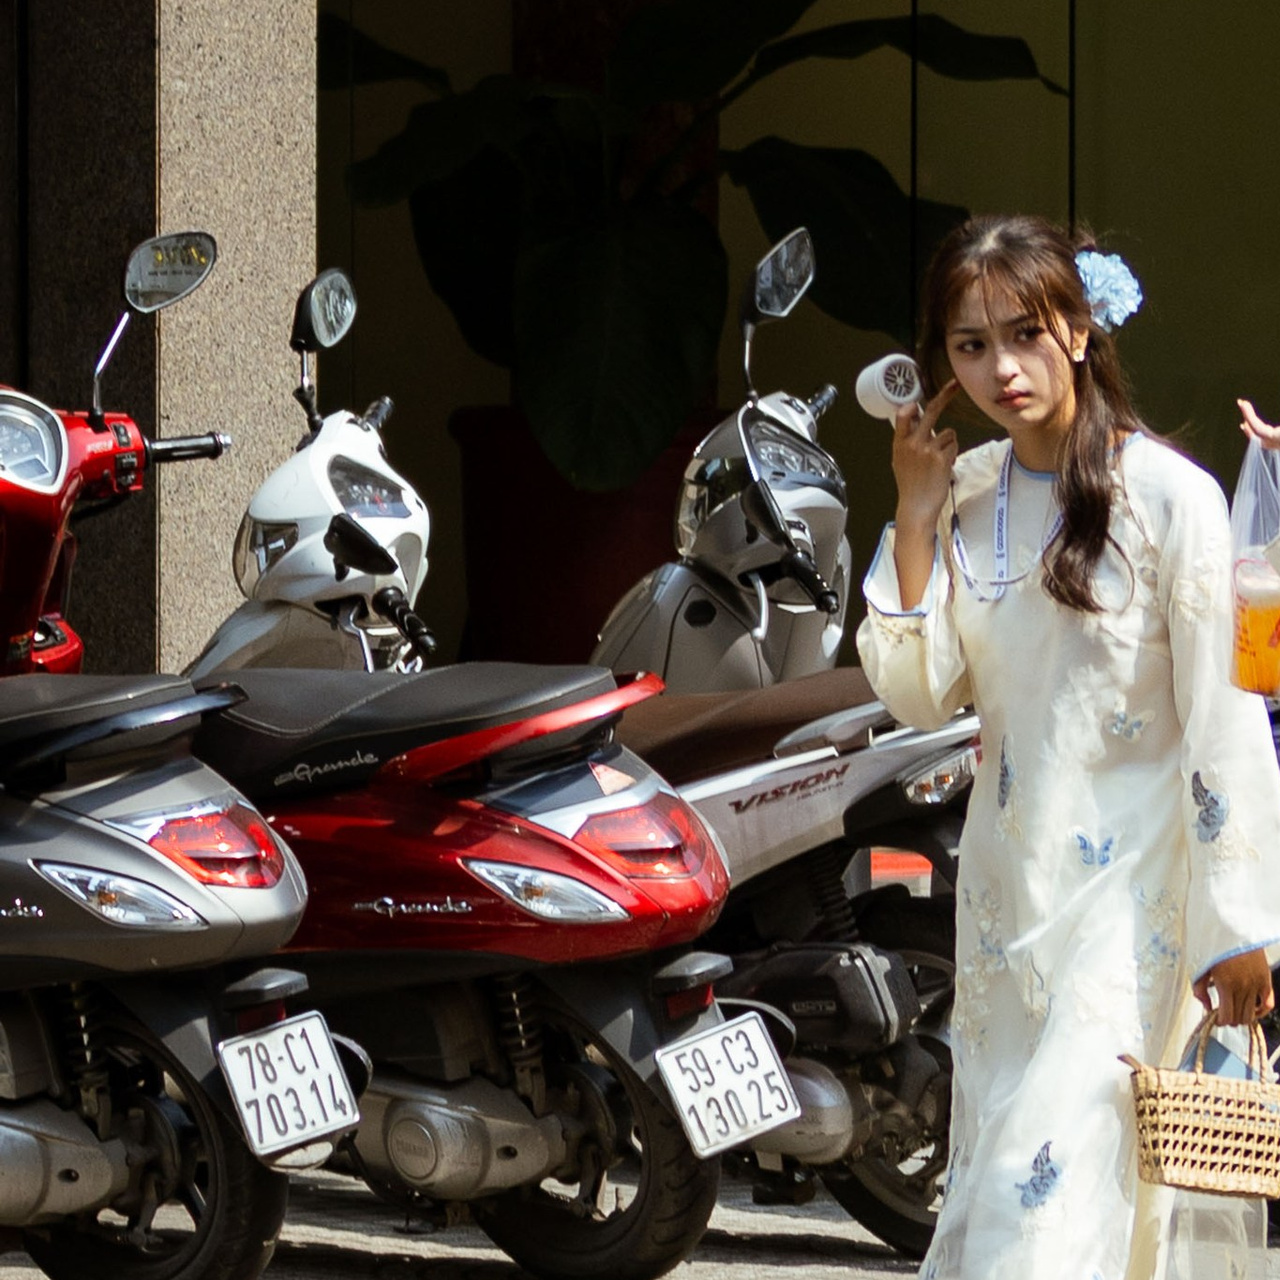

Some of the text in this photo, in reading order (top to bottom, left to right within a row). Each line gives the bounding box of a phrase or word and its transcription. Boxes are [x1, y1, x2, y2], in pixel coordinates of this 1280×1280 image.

[294, 749, 379, 783] Grande
[728, 762, 851, 815] VISION
[237, 1027, 321, 1091] 78-C1
[675, 1029, 760, 1093] 59-C3
[245, 1074, 349, 1144] 703.14
[687, 1069, 789, 1146] 130.25
